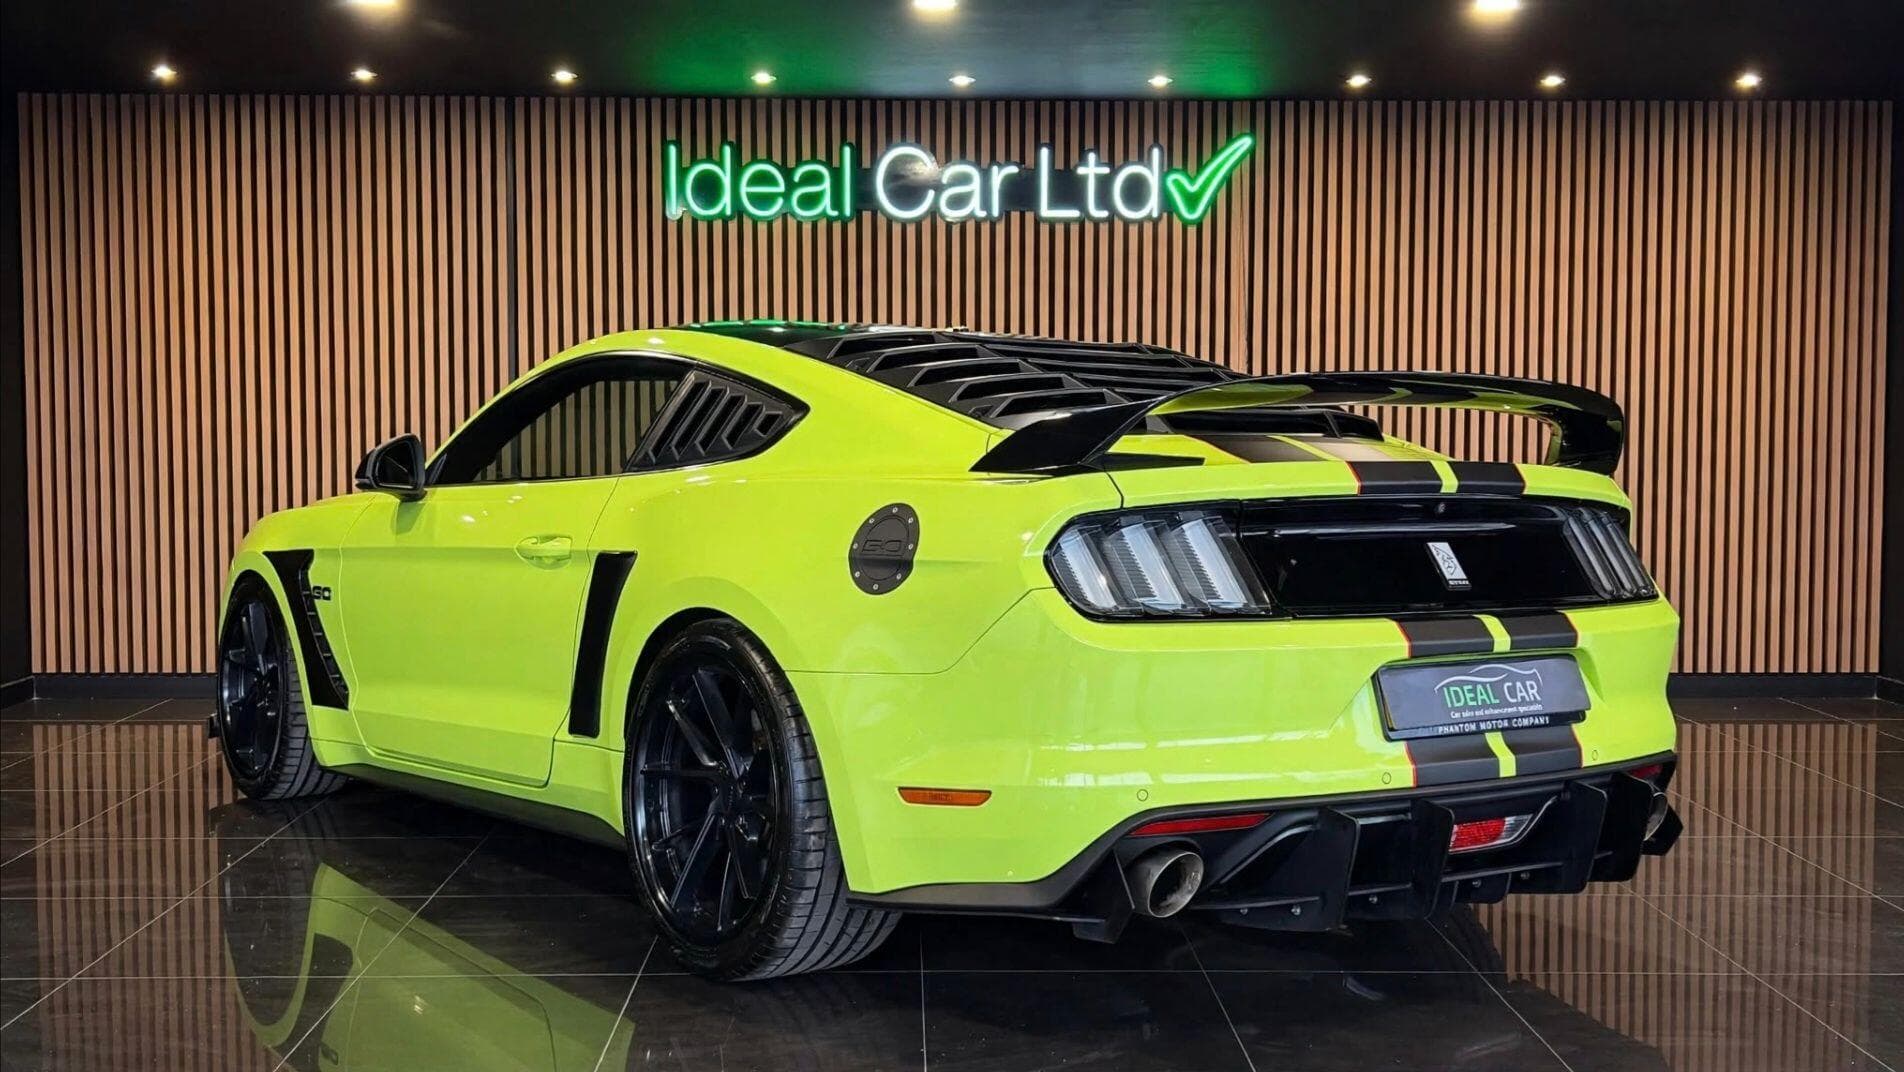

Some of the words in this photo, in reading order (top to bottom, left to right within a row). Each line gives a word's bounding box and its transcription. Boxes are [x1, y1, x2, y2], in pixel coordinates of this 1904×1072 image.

[667, 143, 852, 217] Ideal
[874, 143, 1019, 218] Car
[1039, 143, 1160, 218] Ltd
[1444, 683, 1499, 707] IDEAL
[1504, 680, 1541, 702] CAR
[1438, 722, 1476, 734] PHANTOM
[1479, 719, 1508, 730] MOTOR
[1512, 716, 1550, 727] COMPANY
